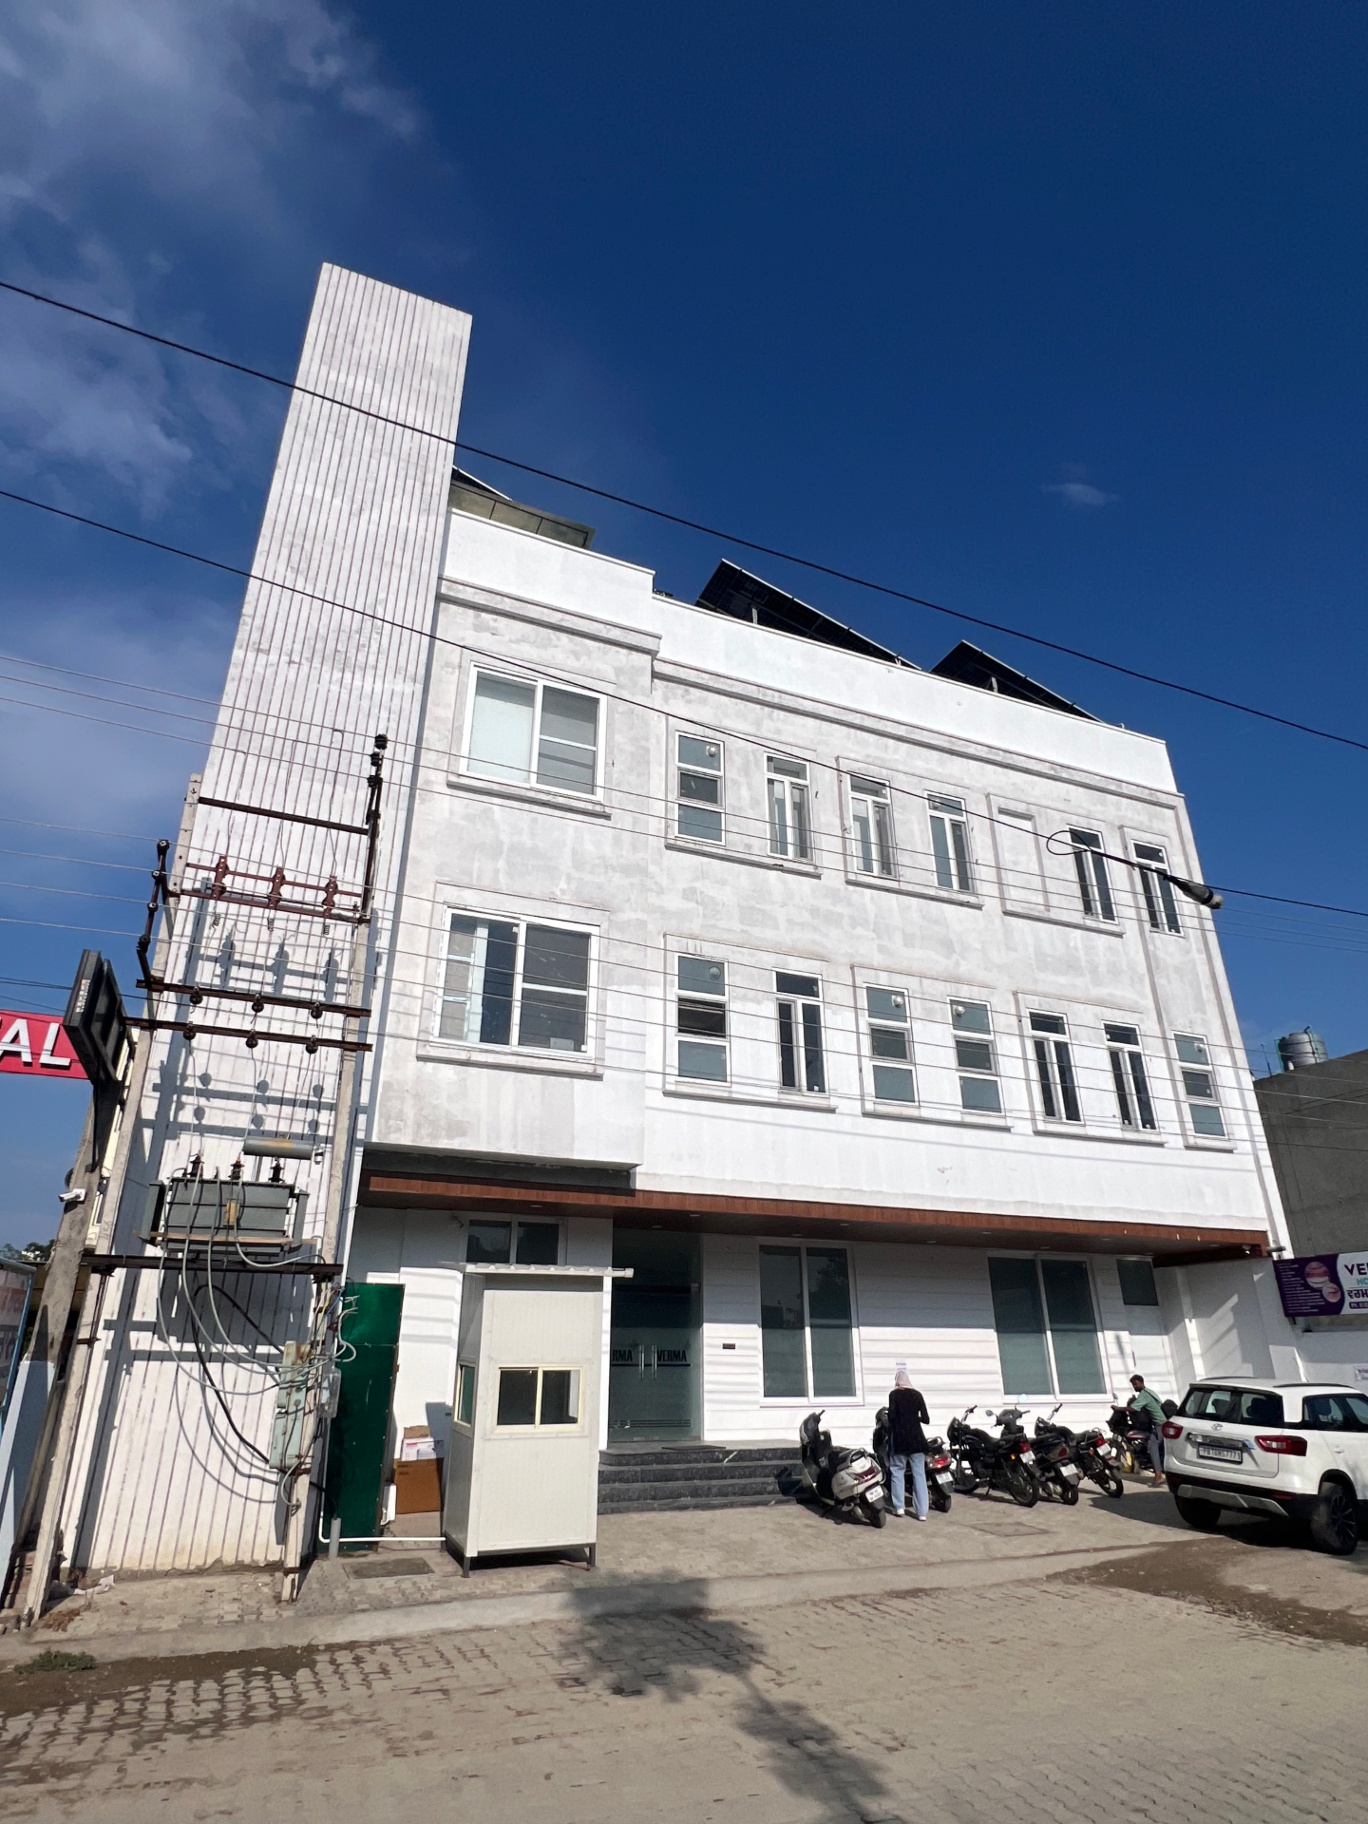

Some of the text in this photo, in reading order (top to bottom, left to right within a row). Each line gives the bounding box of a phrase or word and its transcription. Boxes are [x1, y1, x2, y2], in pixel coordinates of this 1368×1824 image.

[0, 1017, 71, 1066] AL
[1344, 1263, 1368, 1276] VE
[611, 1349, 688, 1362] RMA VERMA
